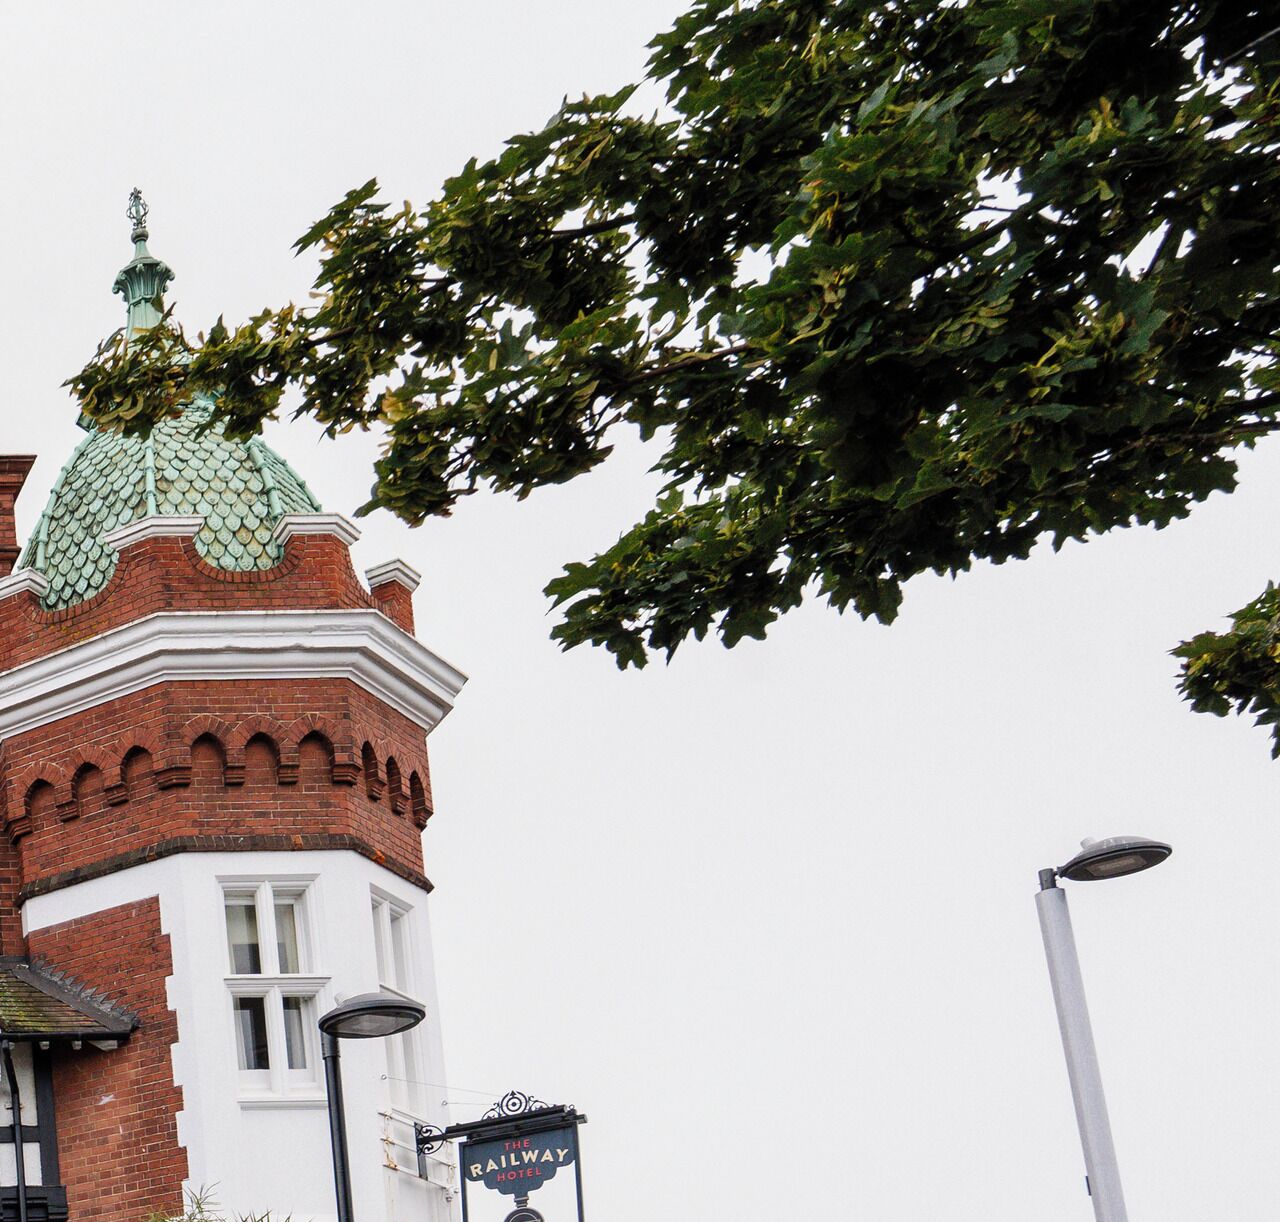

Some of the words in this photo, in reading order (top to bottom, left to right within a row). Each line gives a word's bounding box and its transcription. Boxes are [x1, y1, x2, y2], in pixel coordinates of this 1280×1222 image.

[504, 1138, 532, 1151] THE
[469, 1148, 569, 1178] RAILWAY
[497, 1167, 542, 1182] HOTEL
